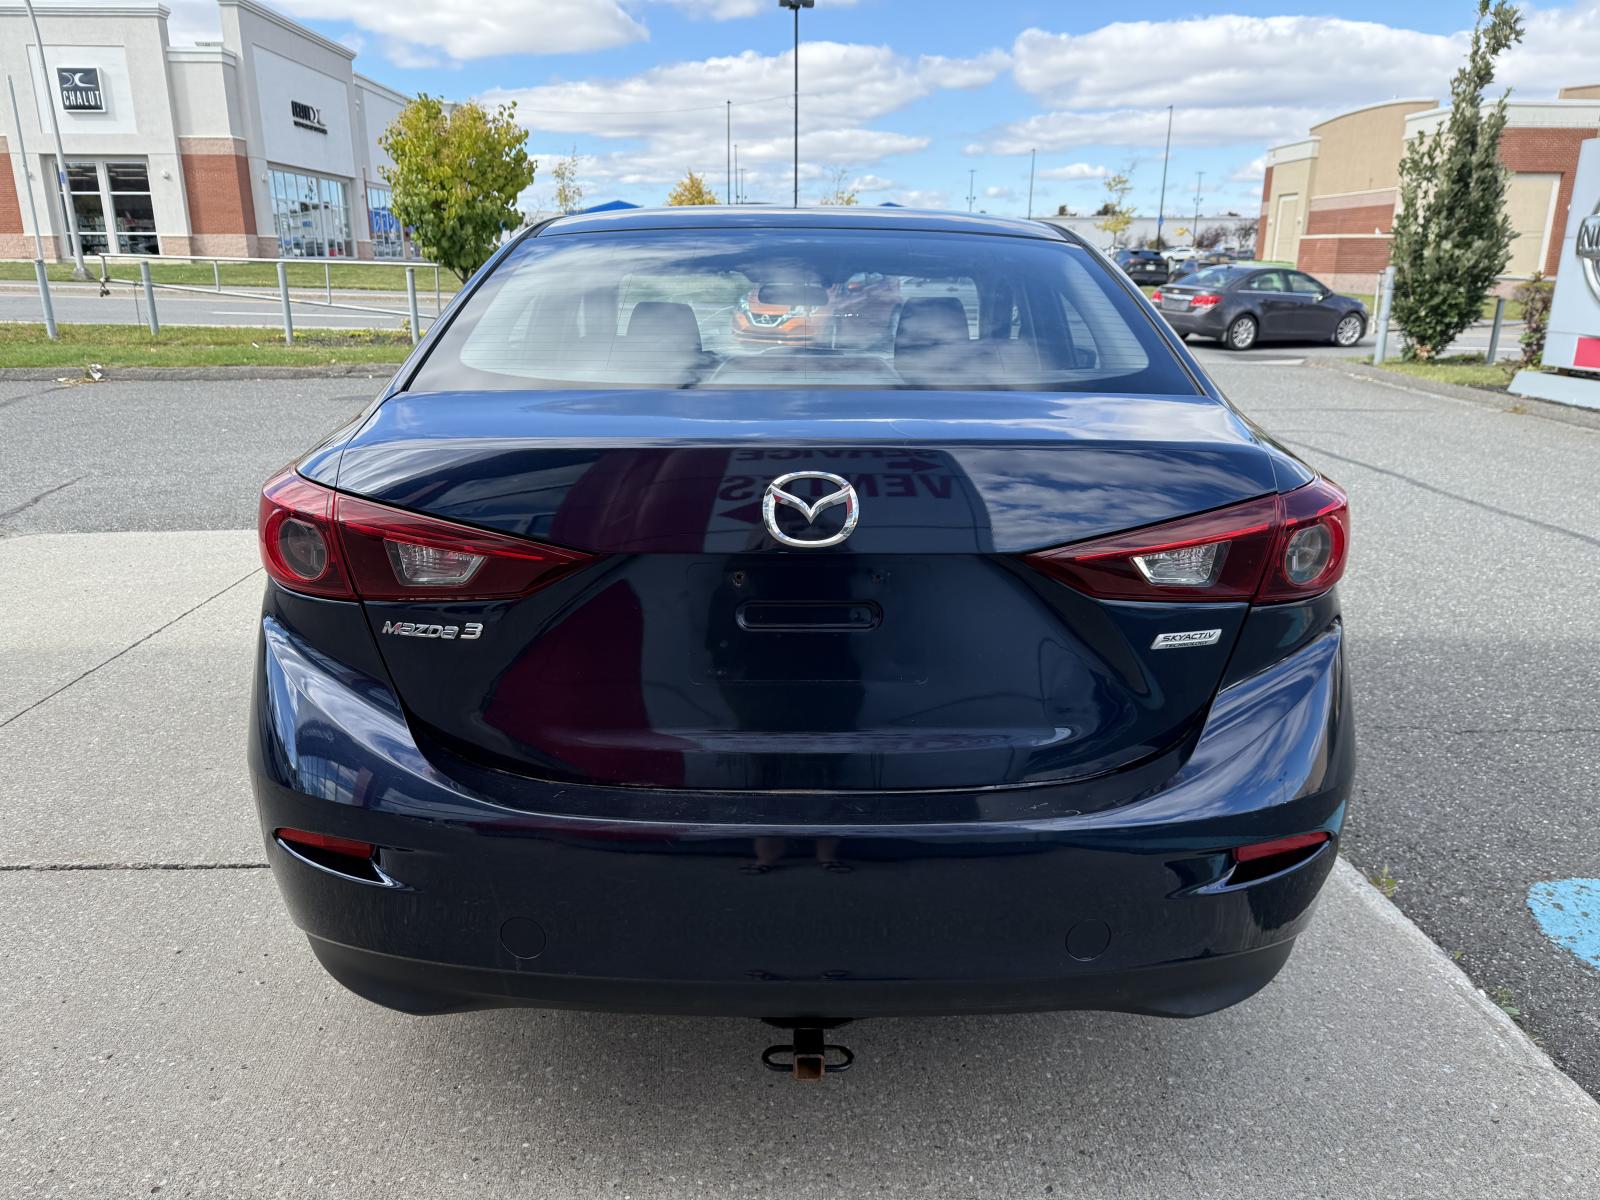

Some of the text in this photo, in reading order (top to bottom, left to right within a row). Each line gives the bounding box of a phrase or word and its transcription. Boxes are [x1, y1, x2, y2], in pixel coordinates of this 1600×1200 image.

[62, 90, 101, 106] CHALUT
[460, 622, 484, 640] 3
[1163, 632, 1216, 641] SKYACTIV
